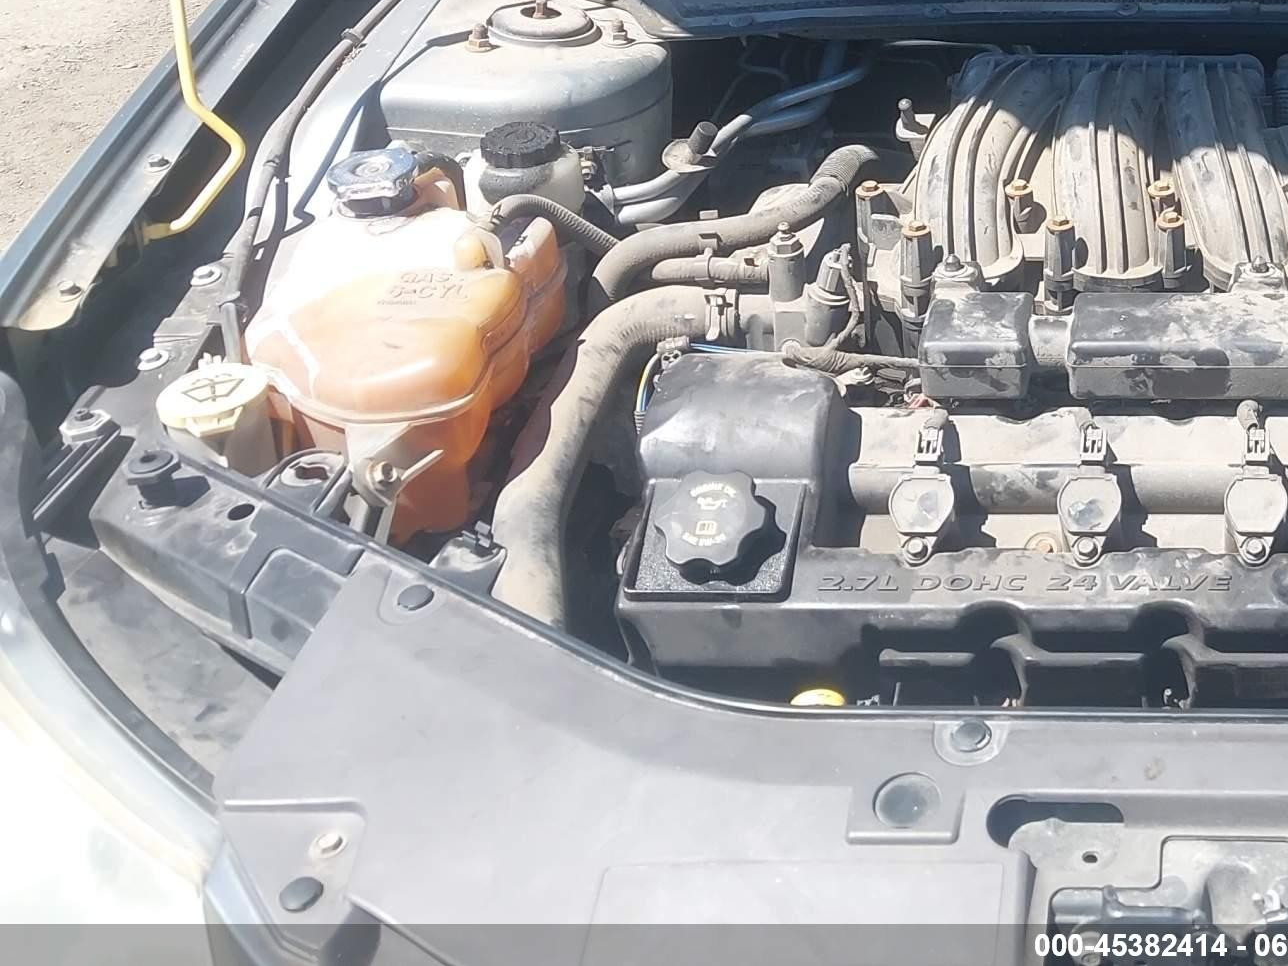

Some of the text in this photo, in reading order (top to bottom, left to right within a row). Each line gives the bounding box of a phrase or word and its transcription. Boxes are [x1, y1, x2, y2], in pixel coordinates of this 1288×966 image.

[816, 574, 1233, 592] 2.7L DOHC 24 VALVE
